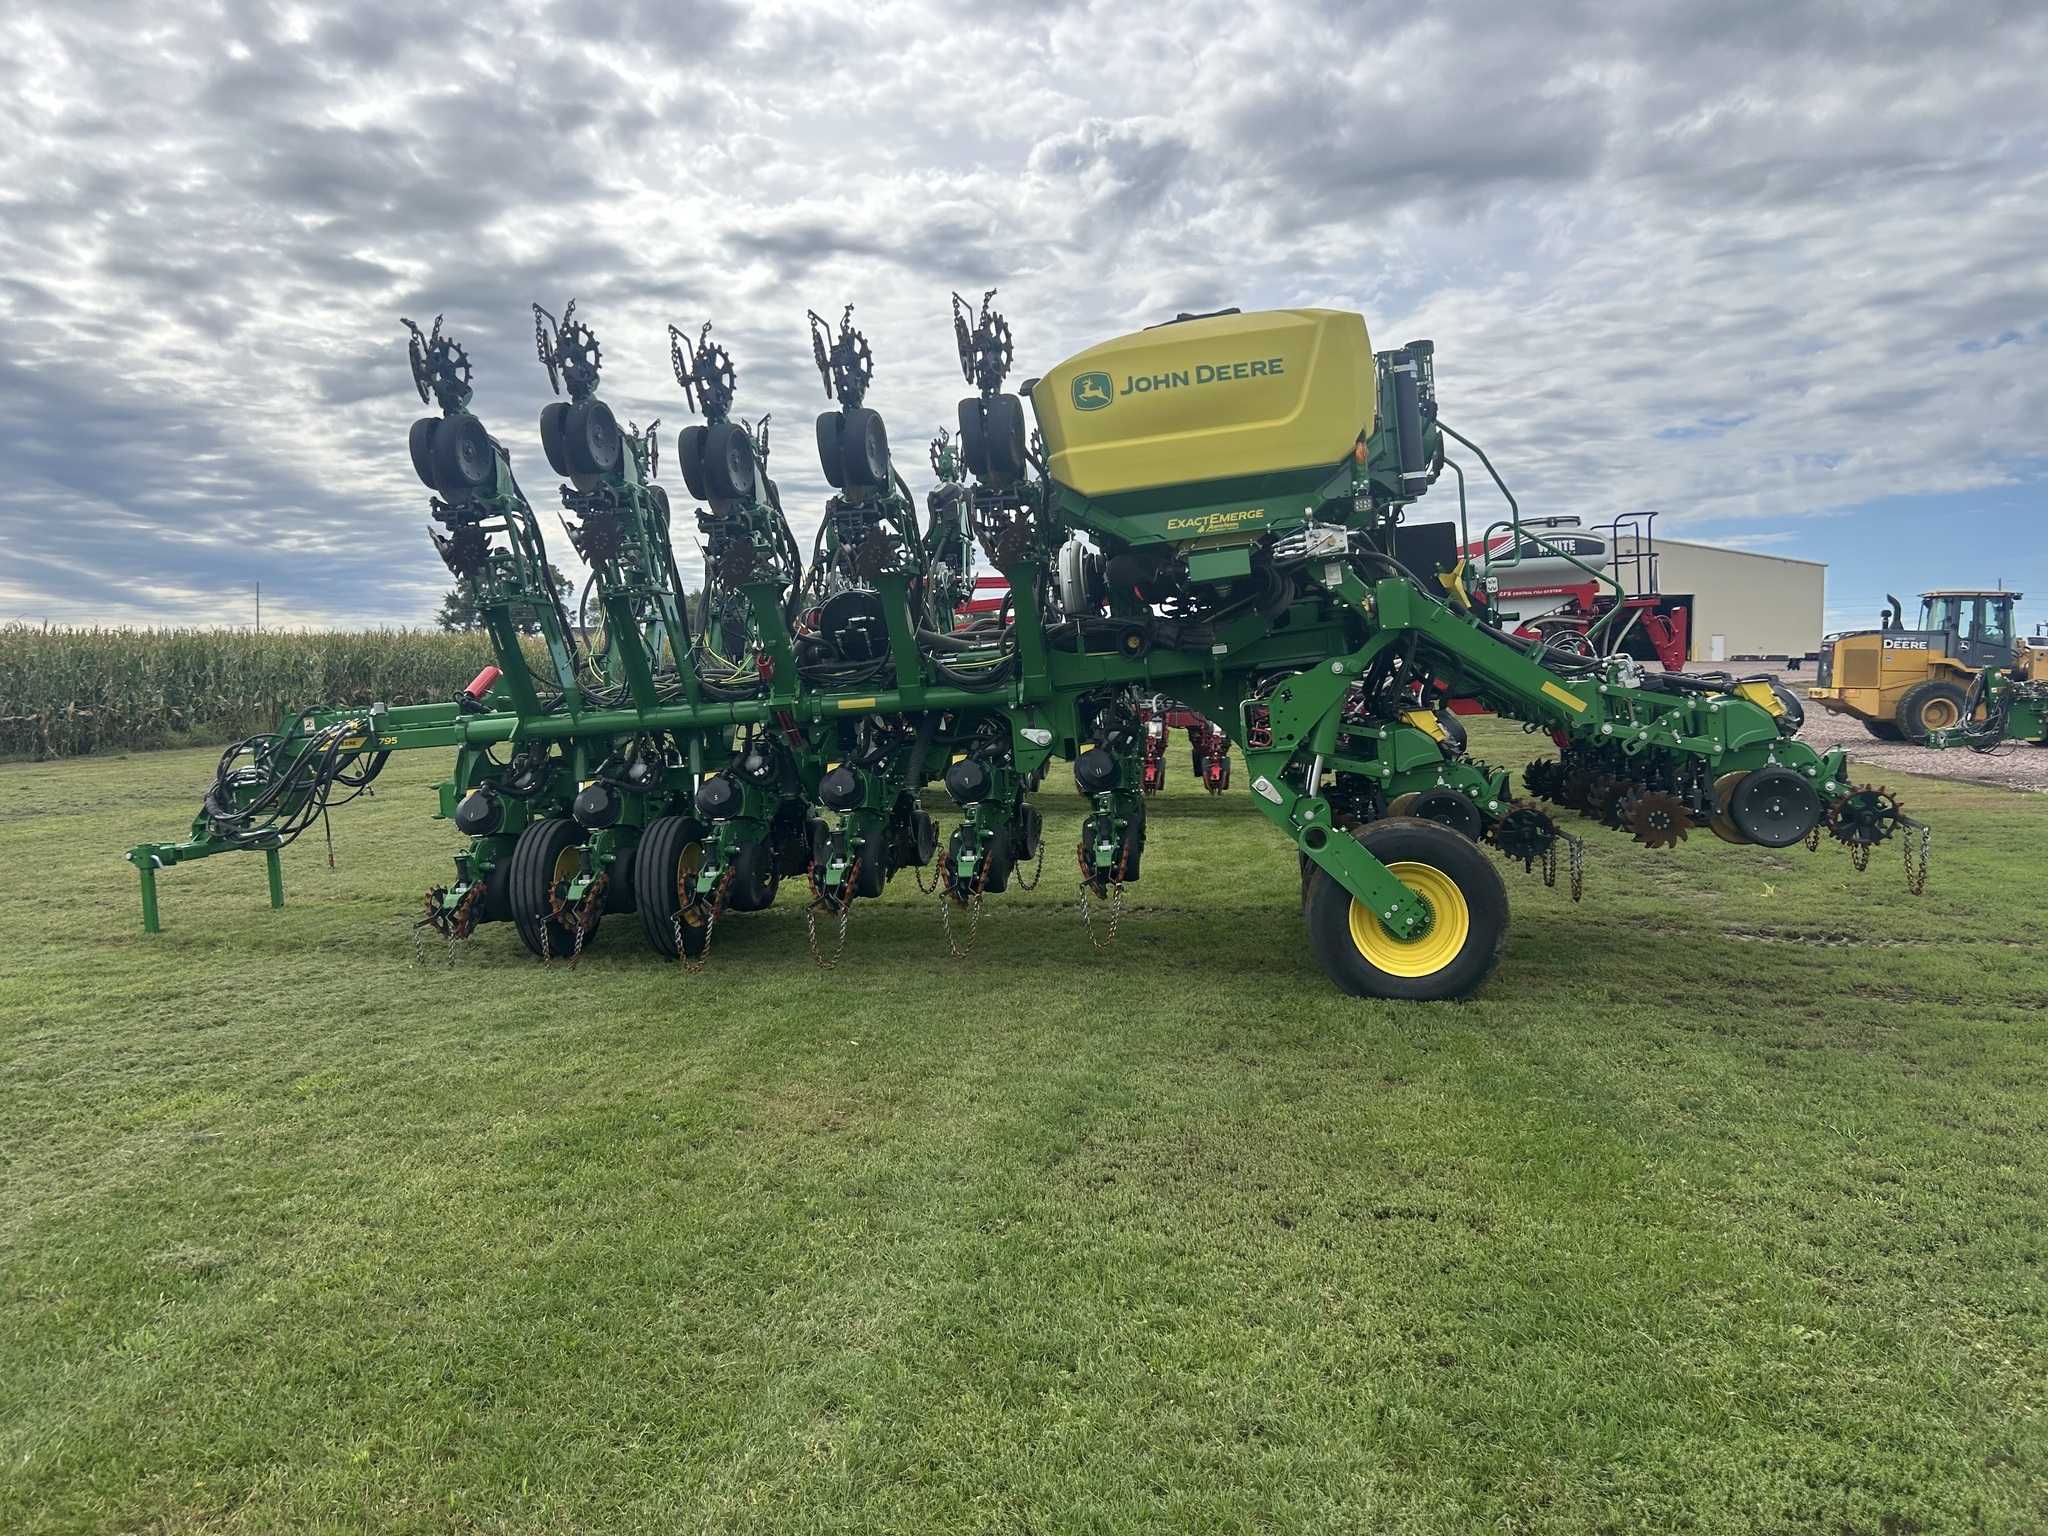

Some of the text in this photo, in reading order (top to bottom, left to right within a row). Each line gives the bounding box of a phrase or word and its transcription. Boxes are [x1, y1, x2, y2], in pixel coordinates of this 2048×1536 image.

[1120, 358, 1285, 396] JOHN DEERE
[1167, 508, 1265, 530] EXACTEMERGE
[1536, 539, 1576, 551] WHITE
[1883, 639, 1928, 650] DEERE
